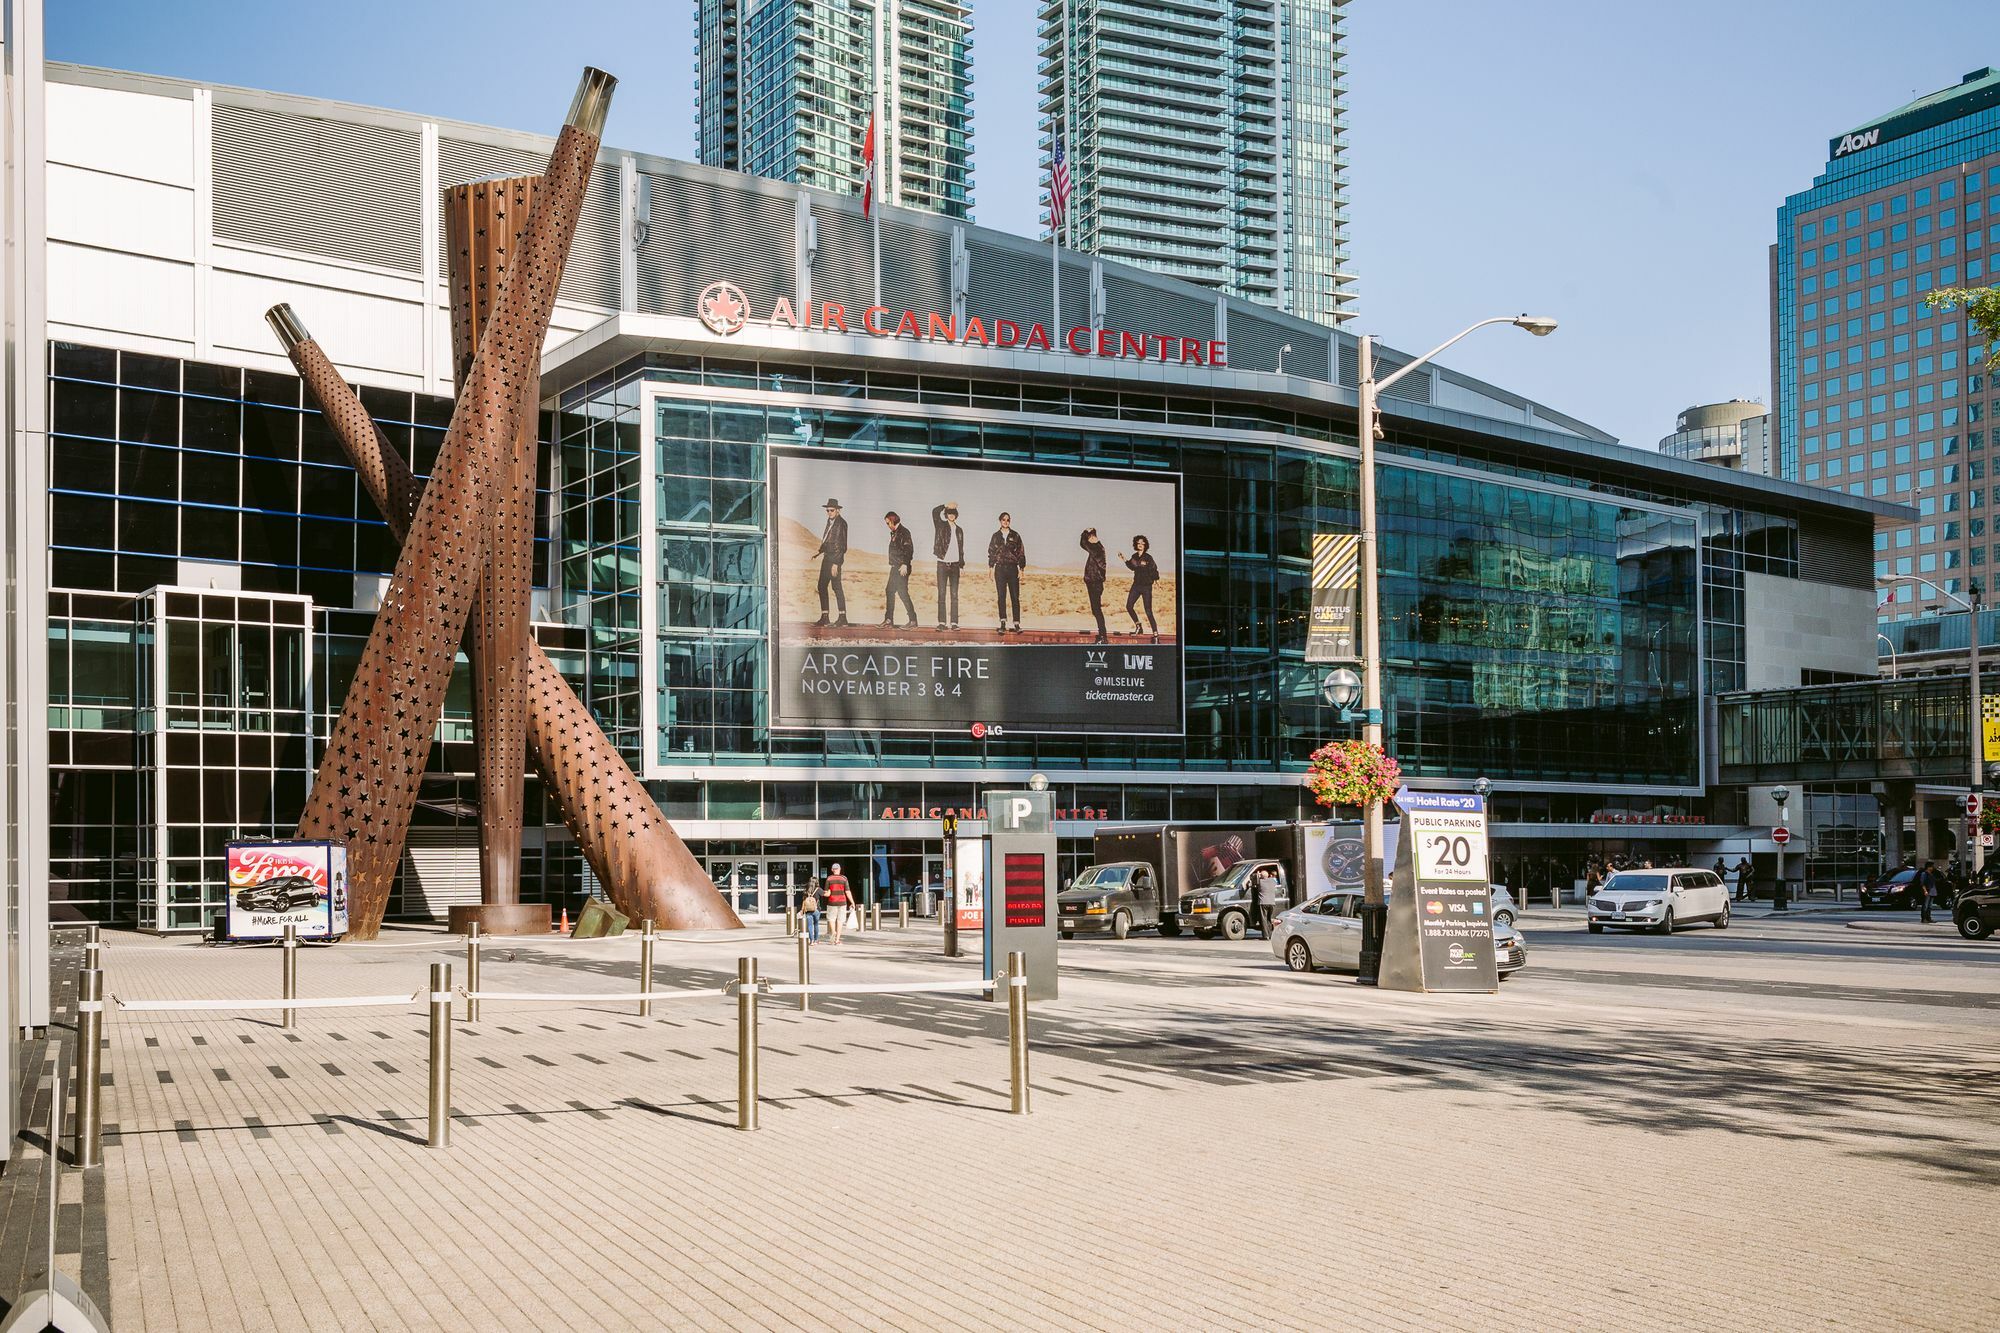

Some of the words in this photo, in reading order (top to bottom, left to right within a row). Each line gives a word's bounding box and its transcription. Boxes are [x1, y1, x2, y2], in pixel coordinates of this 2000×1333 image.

[1835, 129, 1879, 157] AON
[769, 296, 848, 333] AIR
[863, 305, 1051, 351] CANADA
[1066, 326, 1228, 367] CENTRE
[1314, 612, 1344, 620] GAMES
[801, 653, 918, 677] ARCADE
[931, 657, 990, 679] FIRE
[1124, 654, 1153, 670] LIVE
[802, 679, 910, 696] NOVEMBER
[917, 683, 926, 697] 3
[934, 682, 945, 698] &
[952, 683, 962, 697] 4
[1085, 690, 1155, 702] ticketmaster.ca
[987, 725, 1003, 736] LG
[1416, 796, 1440, 807] Hotel
[1441, 797, 1460, 807] Rate
[881, 807, 922, 819] AIR
[929, 807, 988, 819] CANA
[1056, 808, 1108, 821] NTRE
[1011, 798, 1033, 828] P
[1414, 818, 1442, 826] PUBLIC
[1444, 819, 1481, 828] PARKING
[229, 849, 323, 885] Ford
[1420, 886, 1438, 895] Event
[1439, 887, 1456, 895] Rates
[1465, 887, 1487, 897] posted
[1448, 904, 1467, 912] VISA
[251, 916, 278, 927] #MORE
[279, 915, 293, 925] FOR
[294, 914, 309, 923] ALL
[962, 912, 978, 920] JOE
[1424, 919, 1445, 927] Monthly
[1446, 920, 1466, 928] Parking
